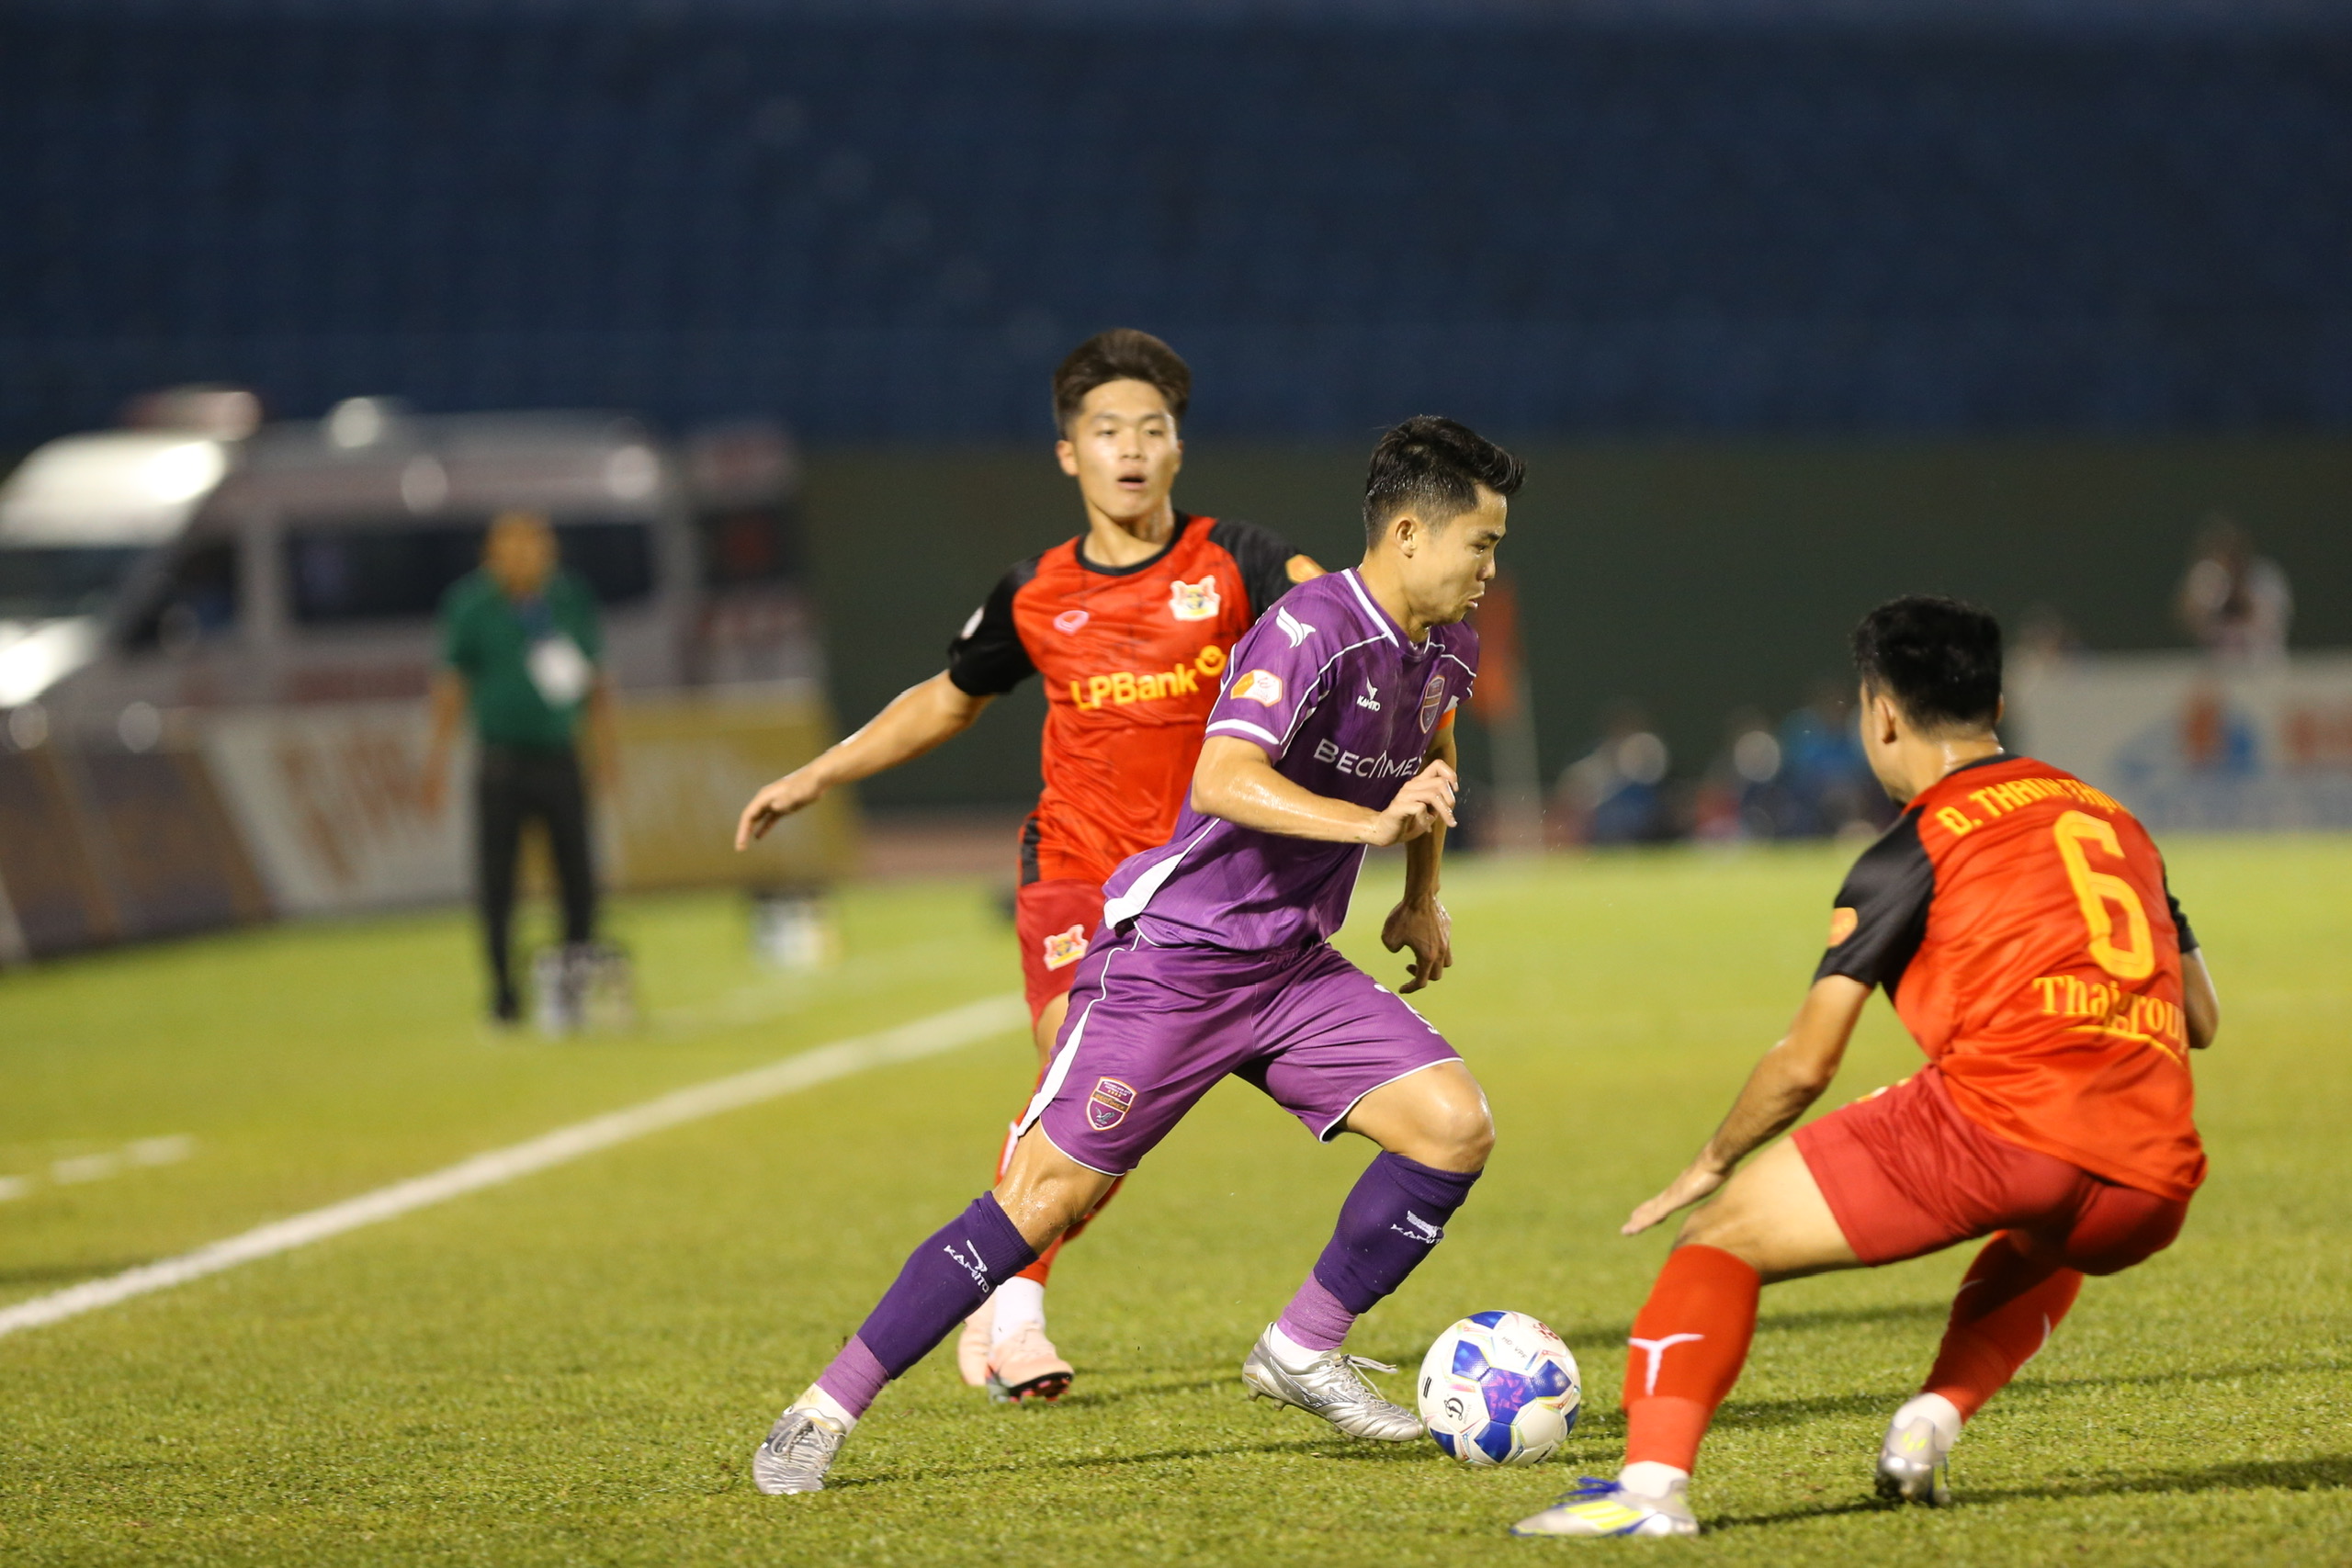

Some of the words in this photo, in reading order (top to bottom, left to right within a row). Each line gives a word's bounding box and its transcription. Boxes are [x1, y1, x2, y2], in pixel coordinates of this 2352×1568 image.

[1069, 662, 1200, 711] LPBank
[1356, 694, 1381, 712] KAMITO
[2053, 809, 2156, 980] 6
[943, 1244, 990, 1293] KAMITO
